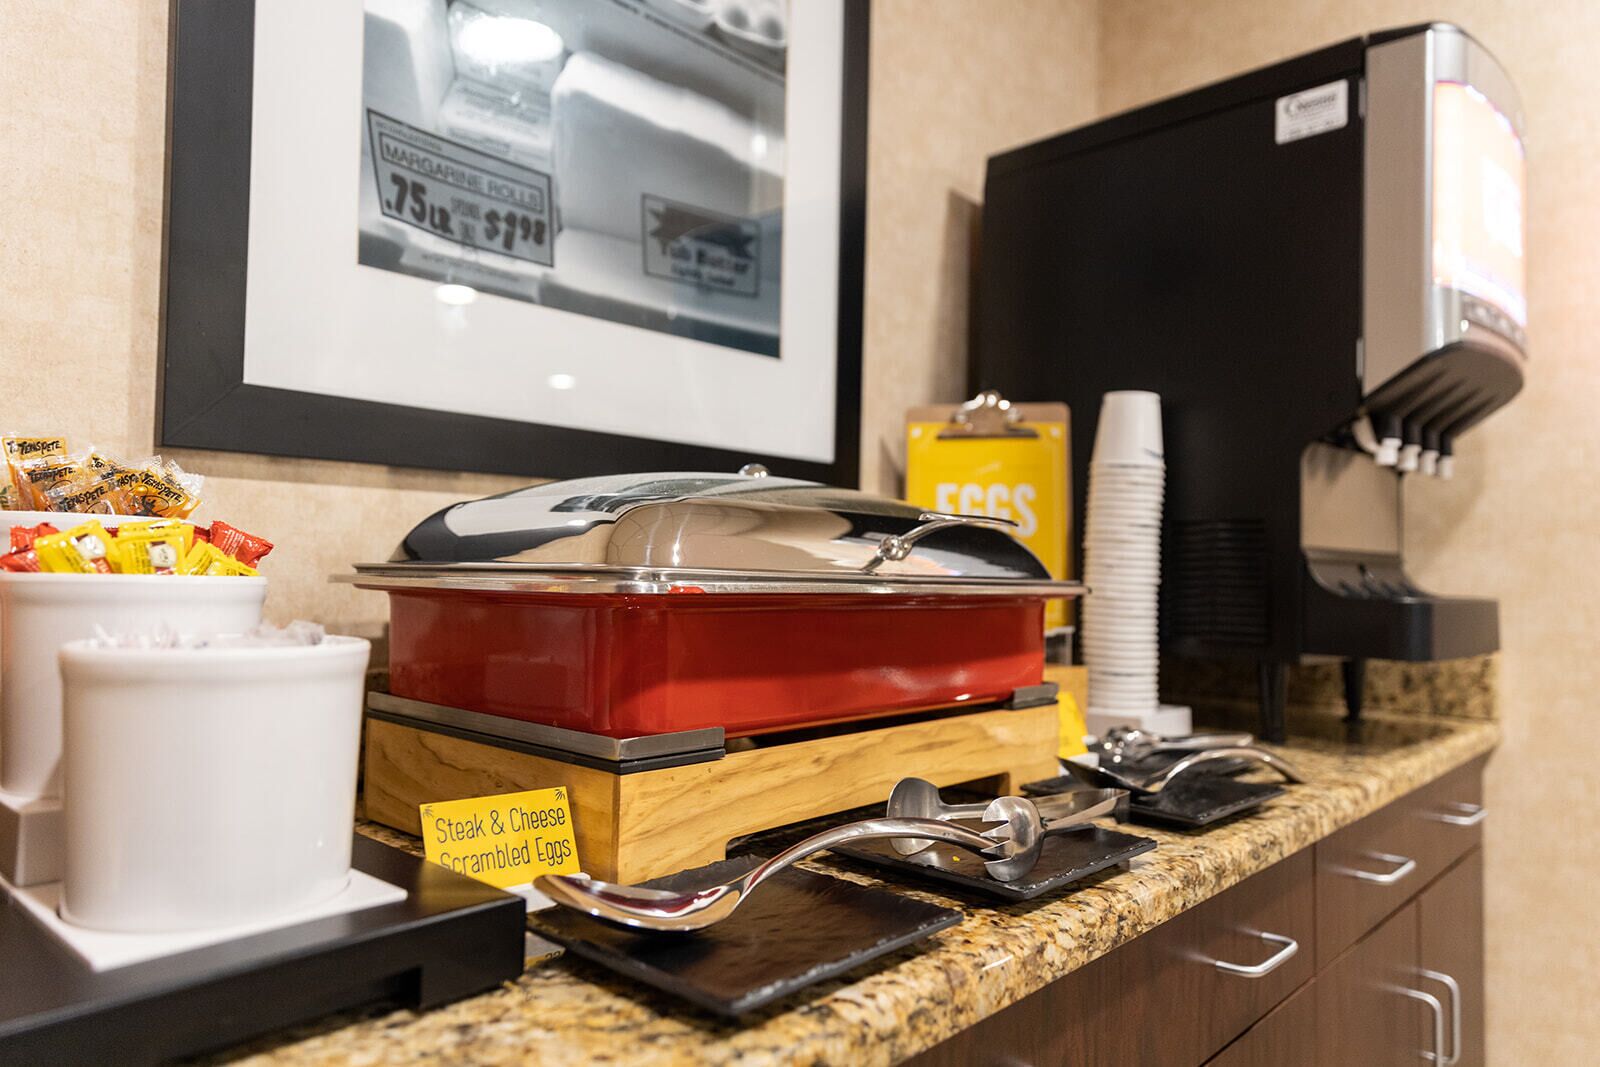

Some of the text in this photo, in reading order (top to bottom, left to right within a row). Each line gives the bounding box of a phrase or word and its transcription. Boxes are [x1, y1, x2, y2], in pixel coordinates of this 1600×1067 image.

[385, 143, 483, 192] MARGARINE
[487, 178, 541, 210] ROLLS
[435, 806, 566, 844] Steak & Cheese
[440, 836, 572, 876] Scrambled Eggs
